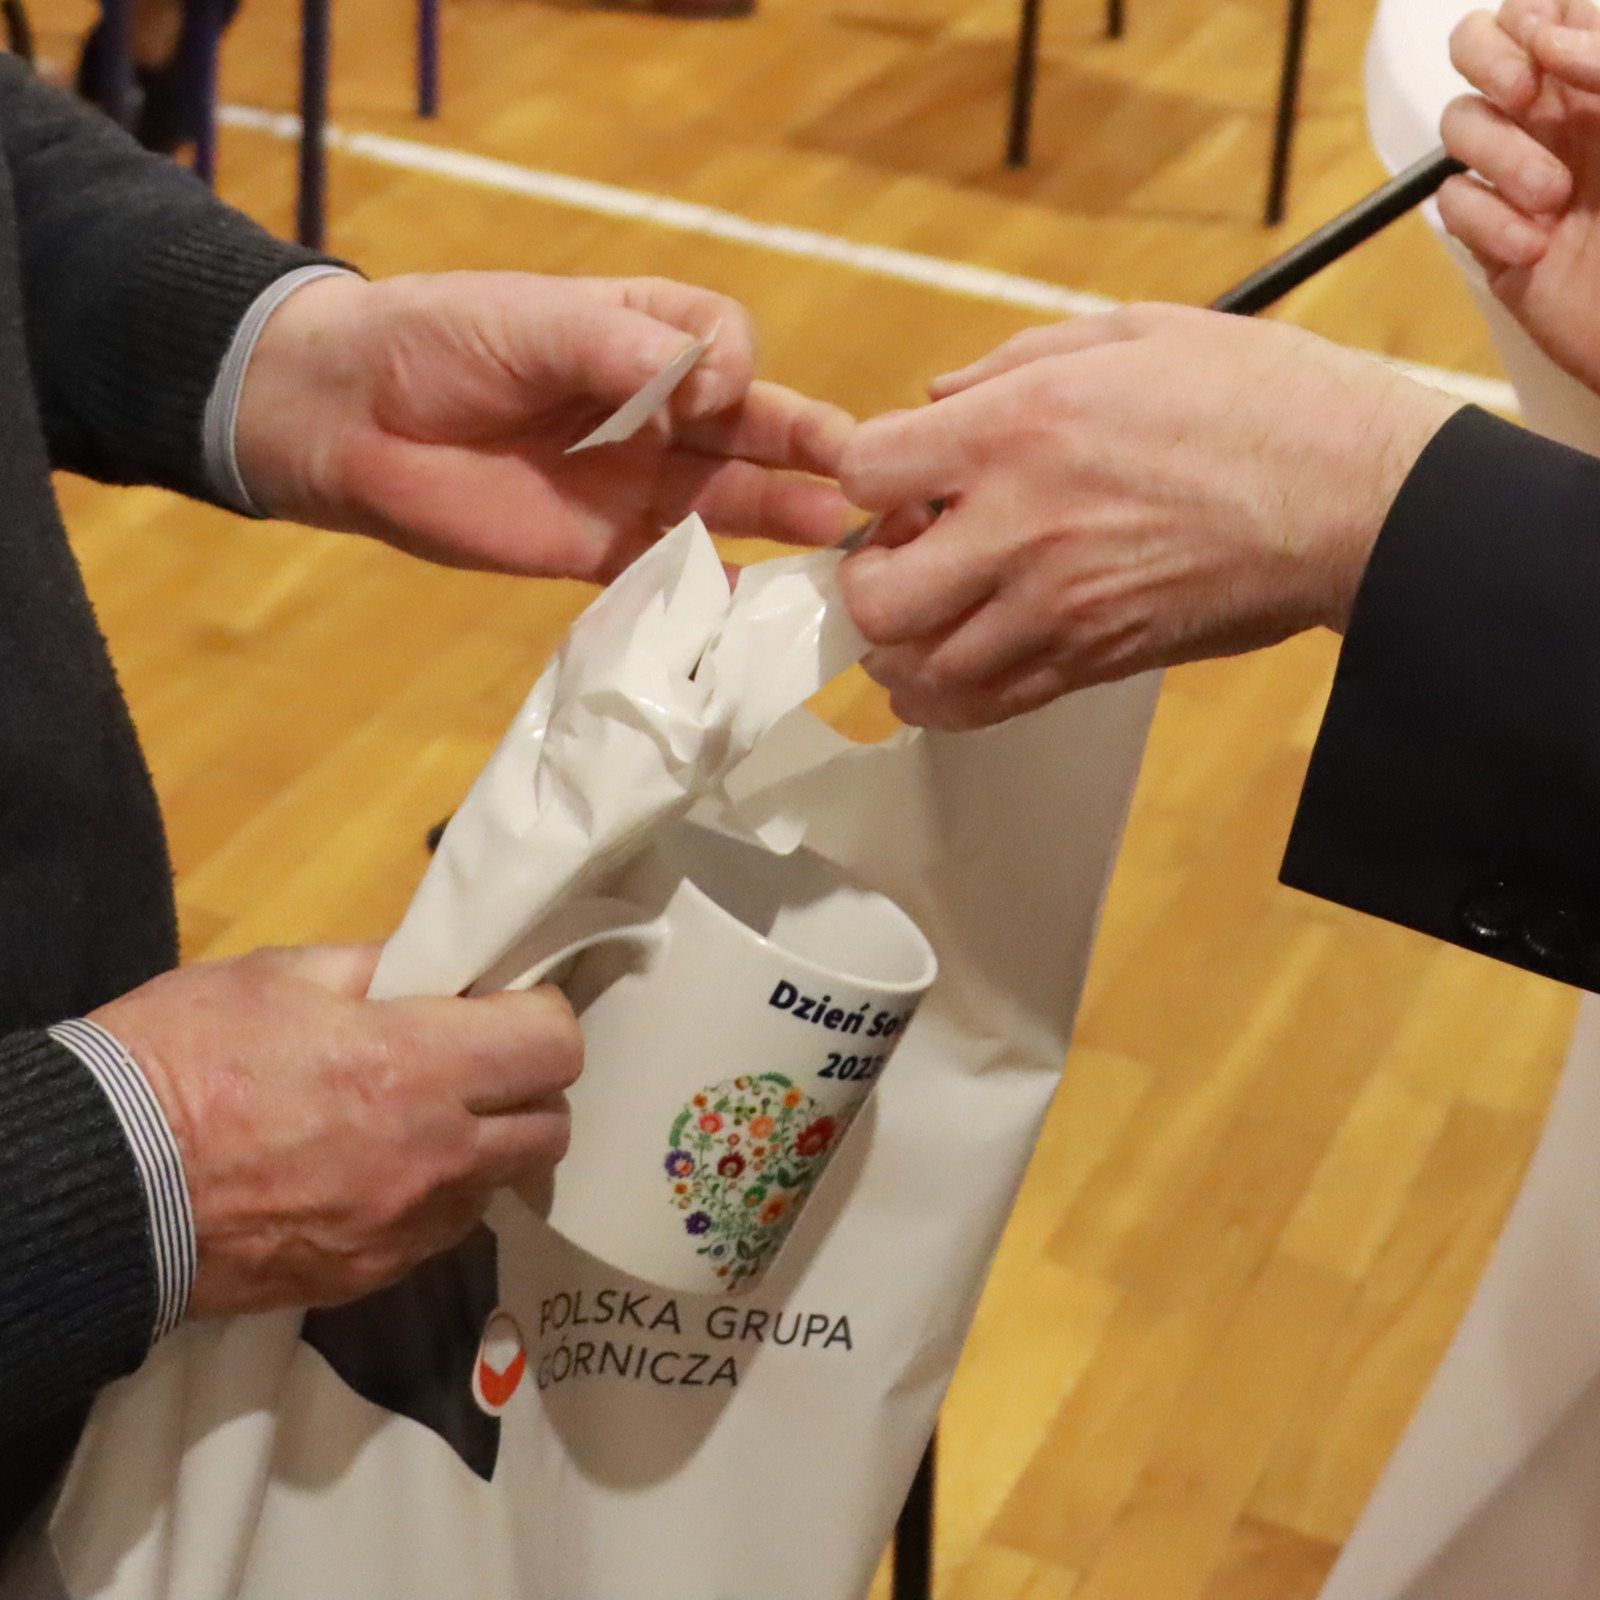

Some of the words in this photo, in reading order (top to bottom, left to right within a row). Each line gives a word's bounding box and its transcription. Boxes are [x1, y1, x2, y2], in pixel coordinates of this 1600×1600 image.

[769, 979, 871, 1034] Dzień
[866, 1007, 912, 1038] So
[539, 1289, 681, 1335] POLSKA
[706, 1306, 853, 1351] GRUPA
[537, 1336, 739, 1390] GÓRNICZA
